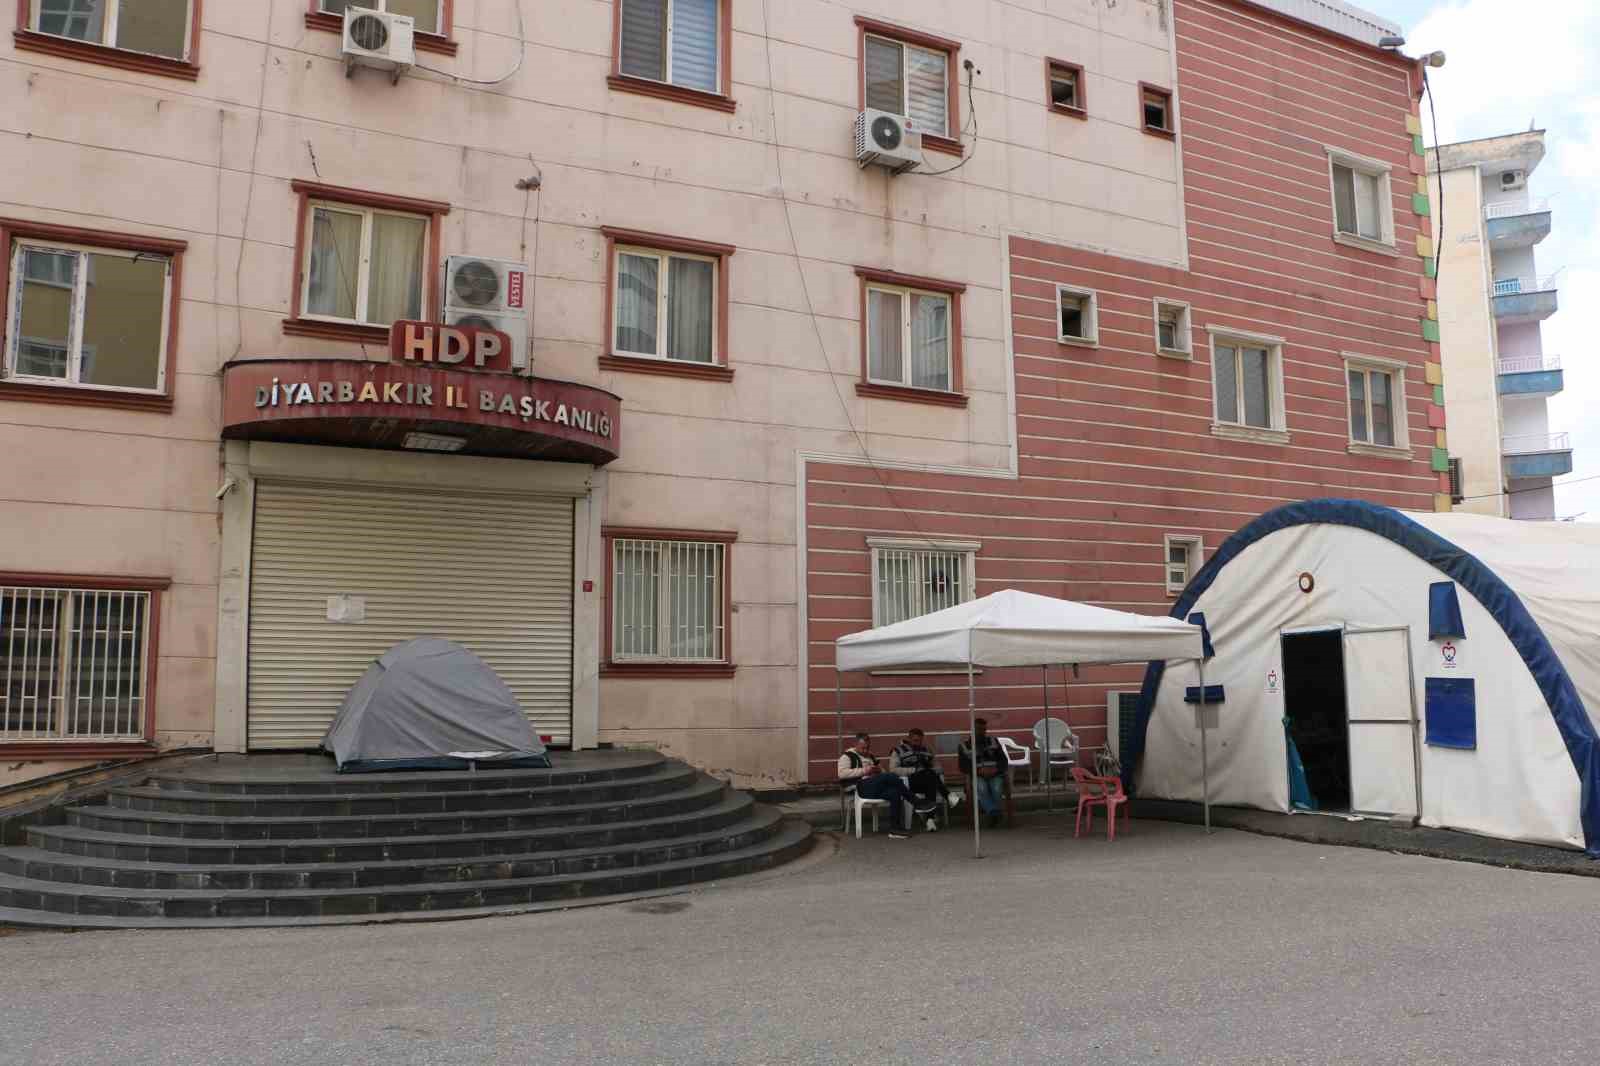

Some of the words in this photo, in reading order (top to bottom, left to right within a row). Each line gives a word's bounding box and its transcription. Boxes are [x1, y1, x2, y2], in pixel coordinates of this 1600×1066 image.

[511, 271, 521, 305] VESTEL
[404, 324, 502, 366] HDP
[255, 377, 433, 407] DİYARBAKIR
[479, 390, 613, 438] BAŞKANLIĞI
